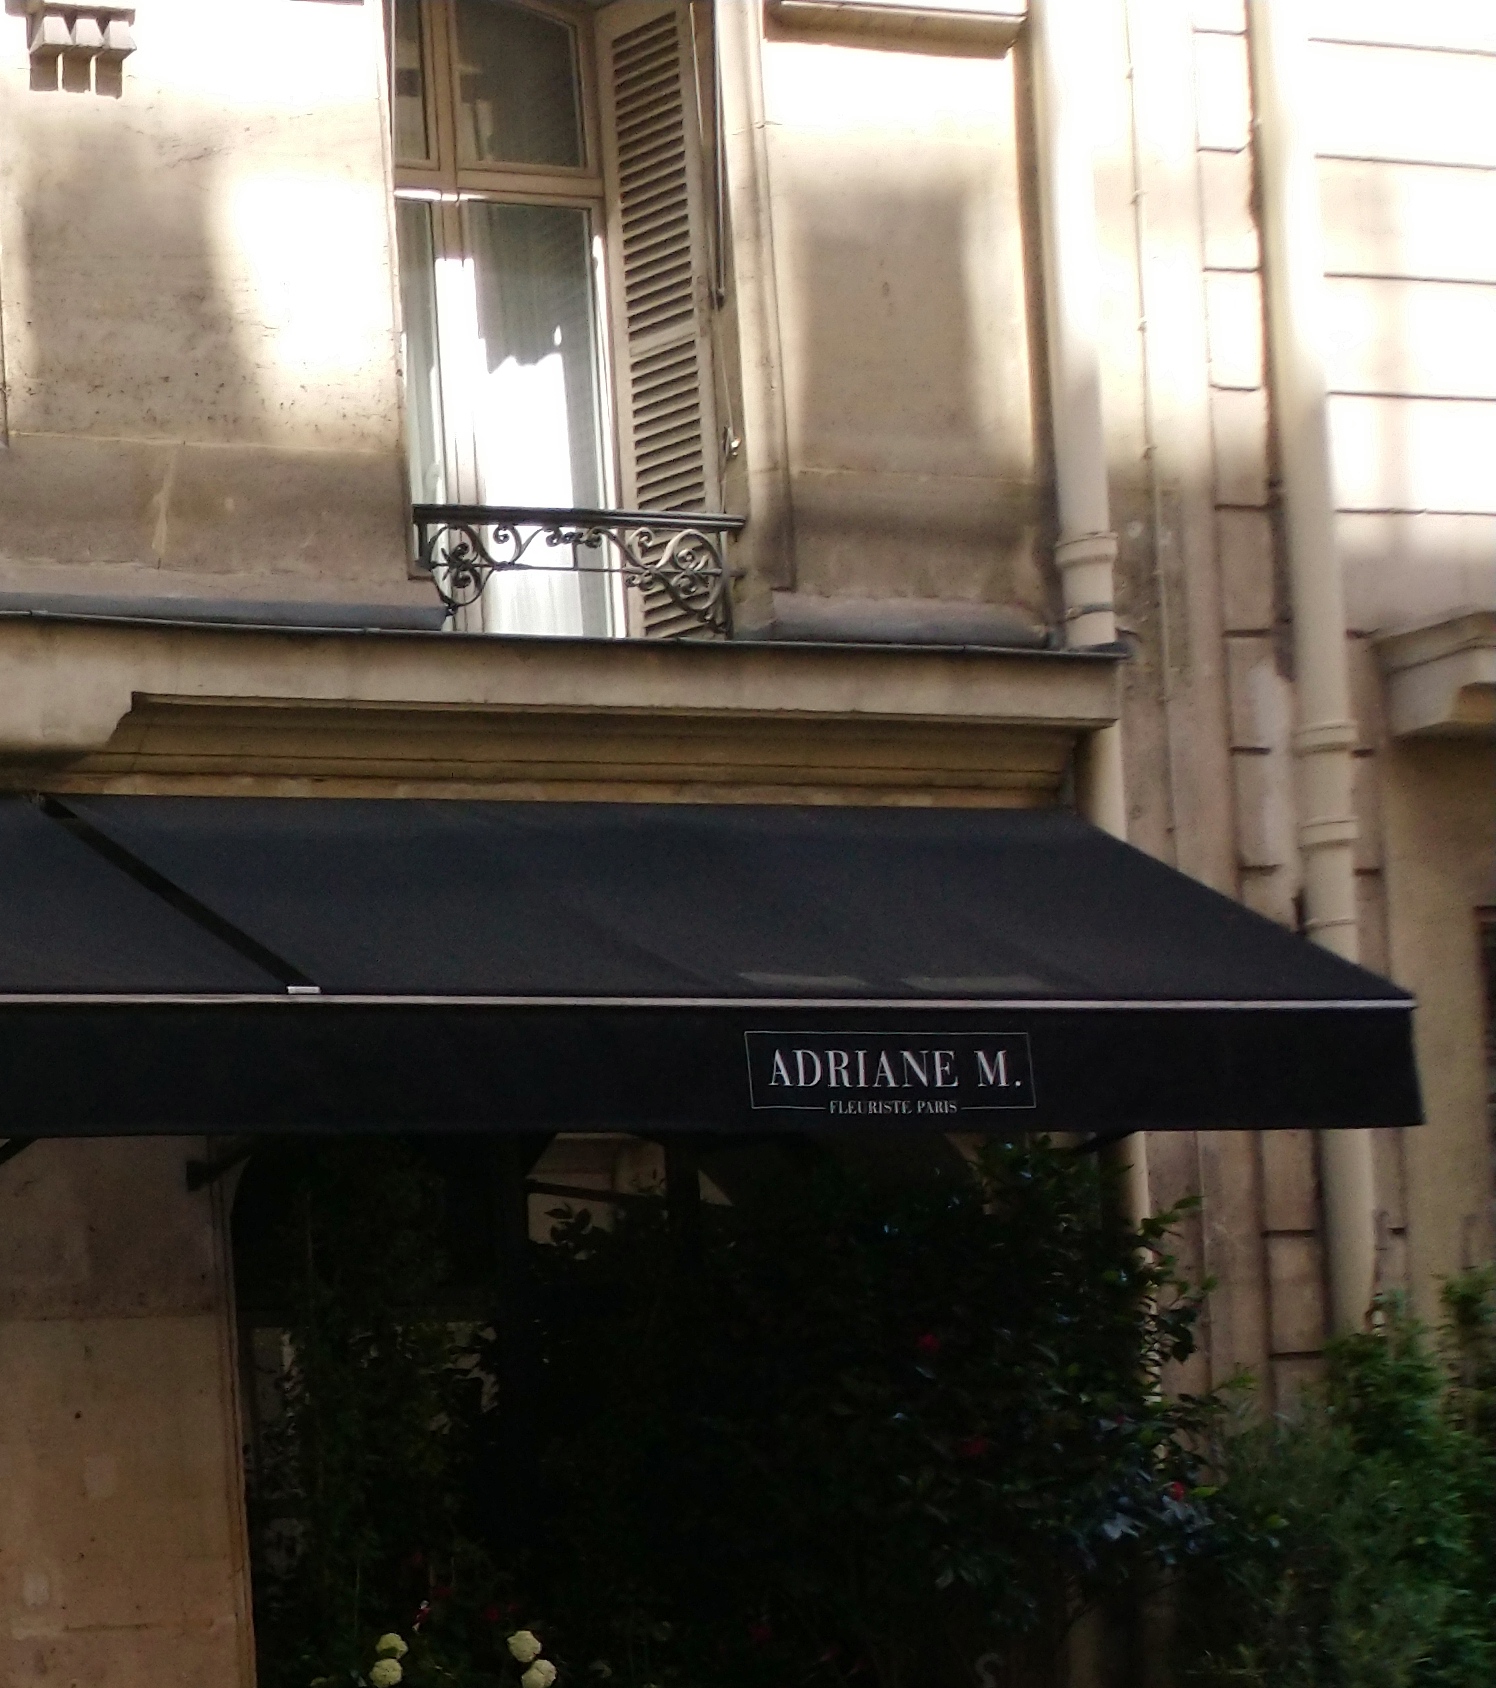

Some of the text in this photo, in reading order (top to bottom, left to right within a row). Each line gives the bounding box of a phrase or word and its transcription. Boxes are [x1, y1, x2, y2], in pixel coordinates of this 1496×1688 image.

[769, 1050, 1020, 1087] ADRIANE M.
[830, 1101, 956, 1114] FLEURISTE PARIS
